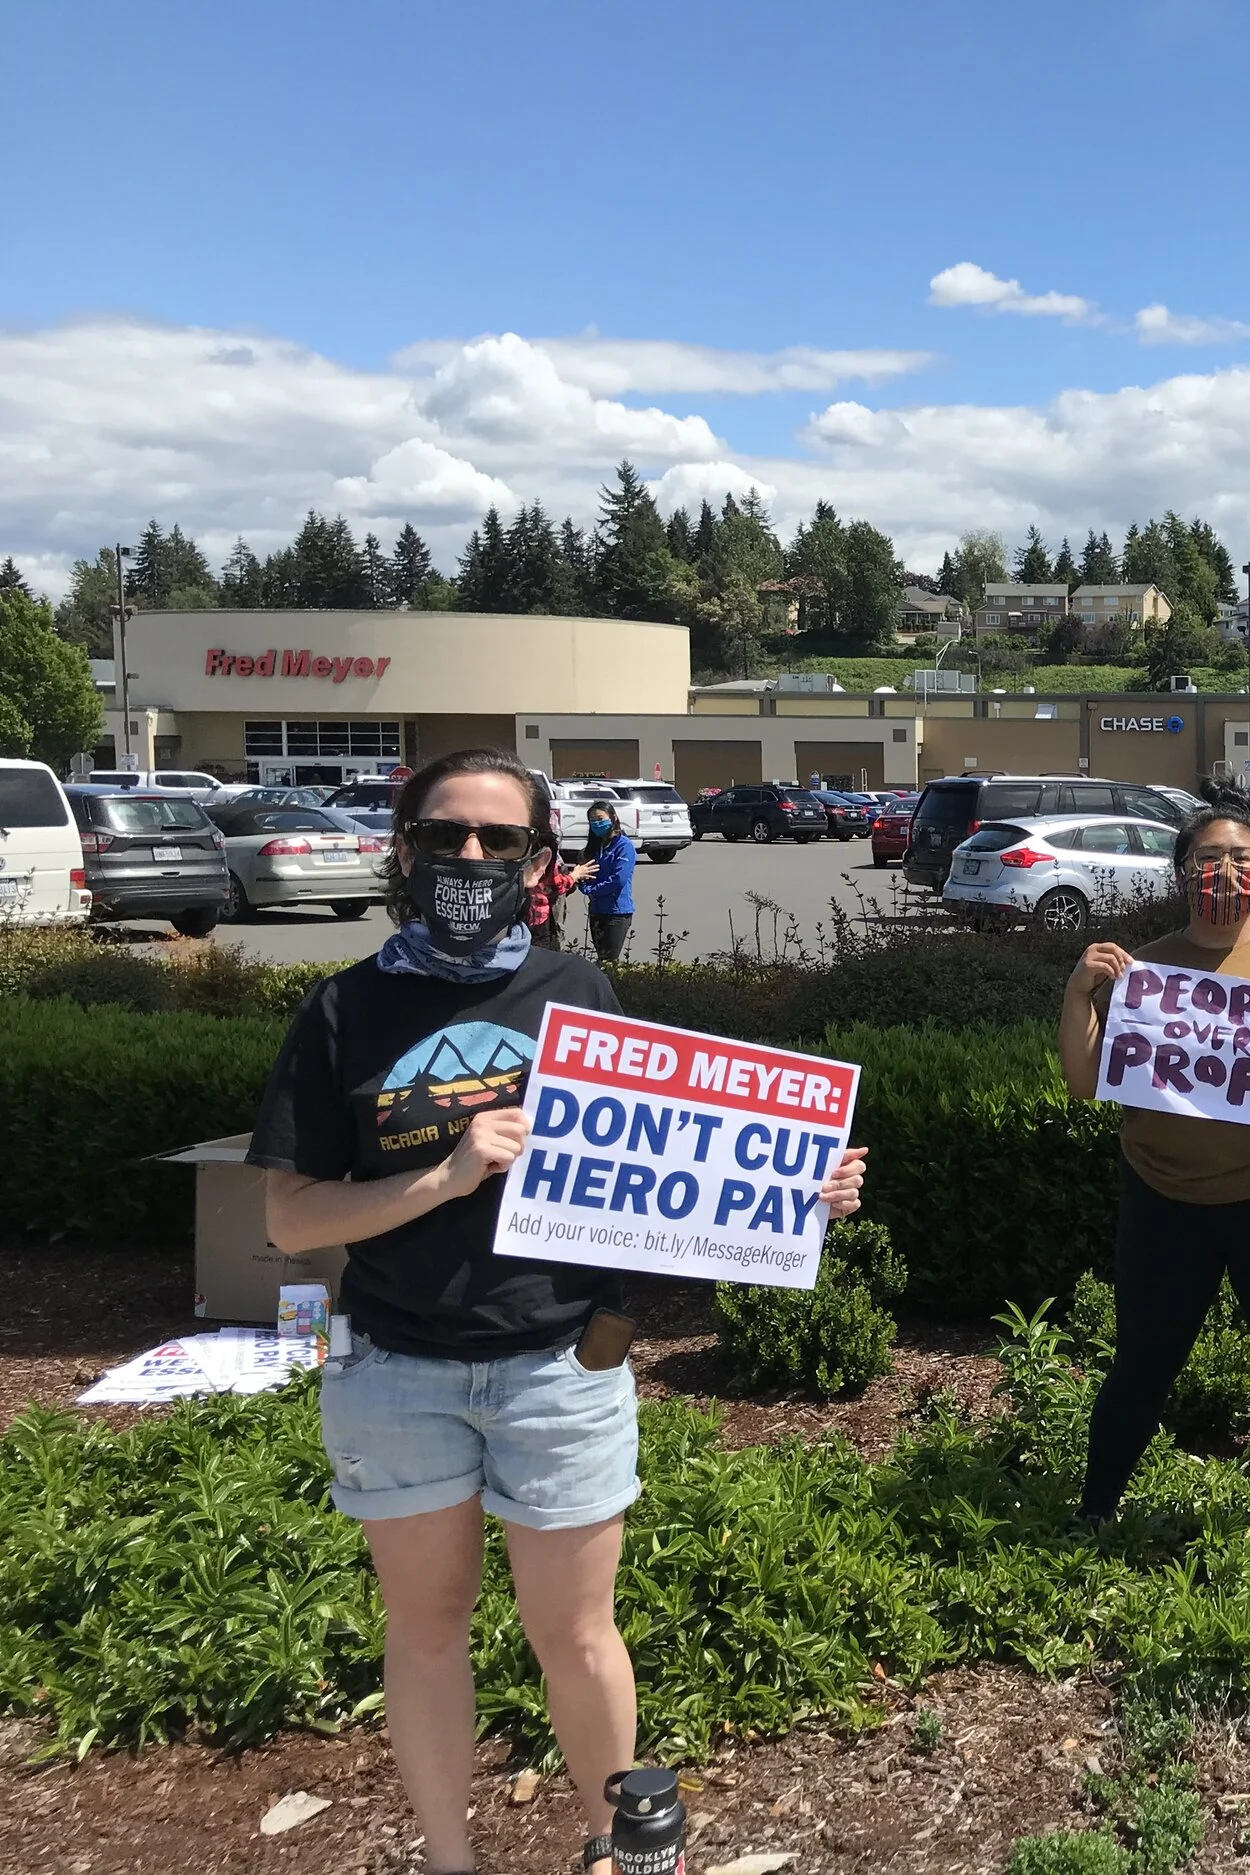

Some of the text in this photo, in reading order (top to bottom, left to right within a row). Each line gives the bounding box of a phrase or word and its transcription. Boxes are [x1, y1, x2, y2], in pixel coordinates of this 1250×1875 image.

[205, 649, 391, 683] Fred Meyer
[1100, 717, 1164, 731] CHASE
[434, 883, 493, 905] FOREVER
[436, 875, 493, 889] ALWAYS A HERO
[435, 900, 492, 921] ESSENTIAL
[1163, 1020, 1250, 1057] OVER
[554, 1024, 842, 1113] FRED MEYER:
[379, 1125, 440, 1151] ACADIA
[532, 1085, 840, 1181] DON'T CUT
[520, 1150, 822, 1236] HERO PAY
[507, 1211, 807, 1270] Add your voice: bit.ly/MessageKroger
[619, 1856, 676, 1874] OULDERS
